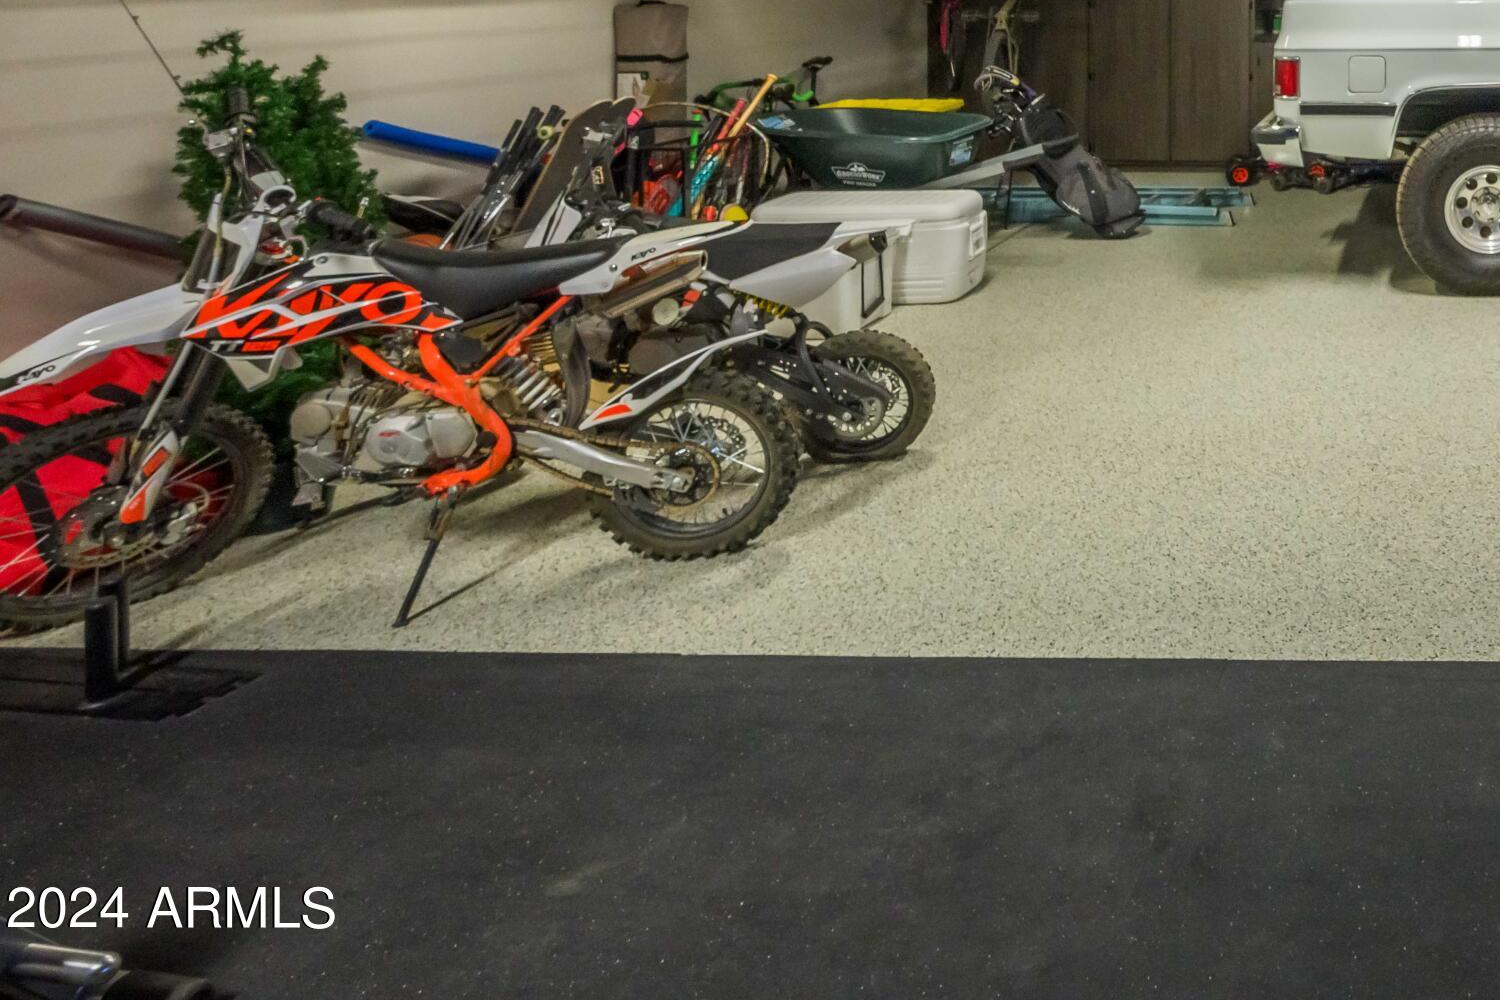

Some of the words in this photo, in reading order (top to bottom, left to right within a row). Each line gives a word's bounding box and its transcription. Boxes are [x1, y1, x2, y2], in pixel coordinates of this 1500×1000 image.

[631, 247, 657, 261] KAYO
[189, 272, 423, 345] KAYO
[210, 340, 245, 352] TT
